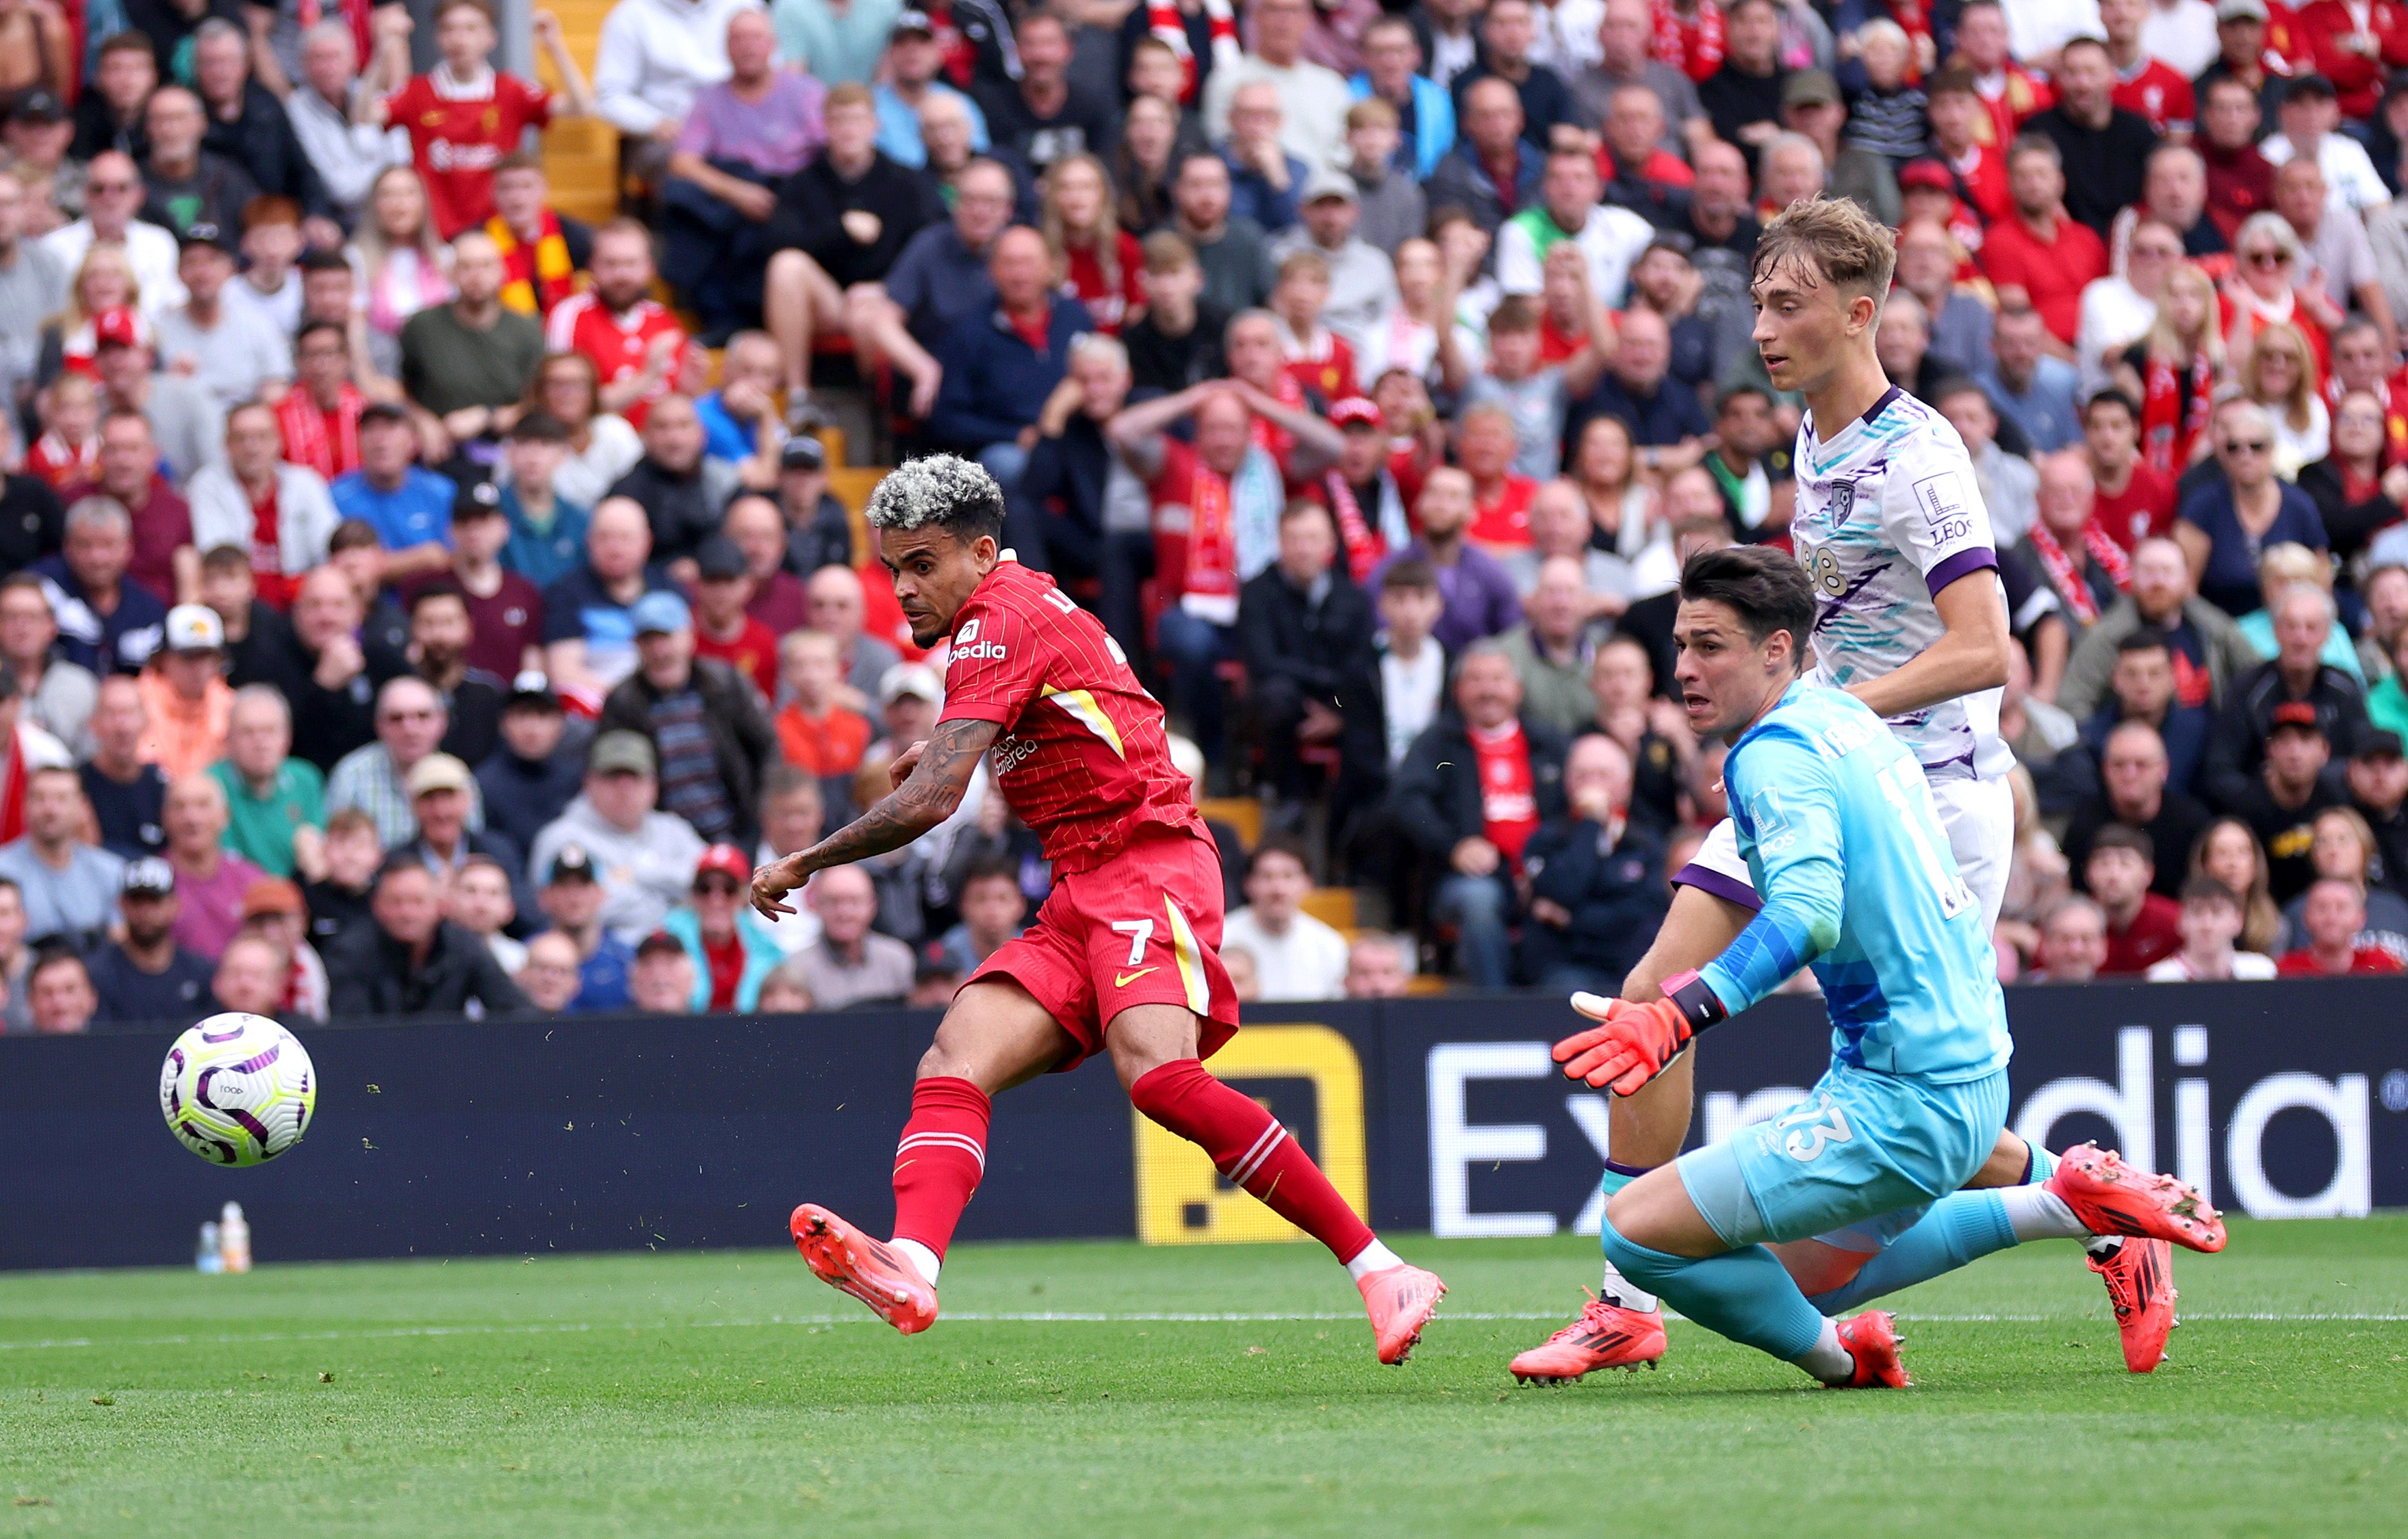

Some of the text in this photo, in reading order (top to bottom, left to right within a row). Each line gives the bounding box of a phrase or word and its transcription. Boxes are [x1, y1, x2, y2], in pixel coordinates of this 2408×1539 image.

[1793, 533, 1848, 597] 88
[1111, 919, 1154, 966] 7
[1776, 1091, 1854, 1162] 13
